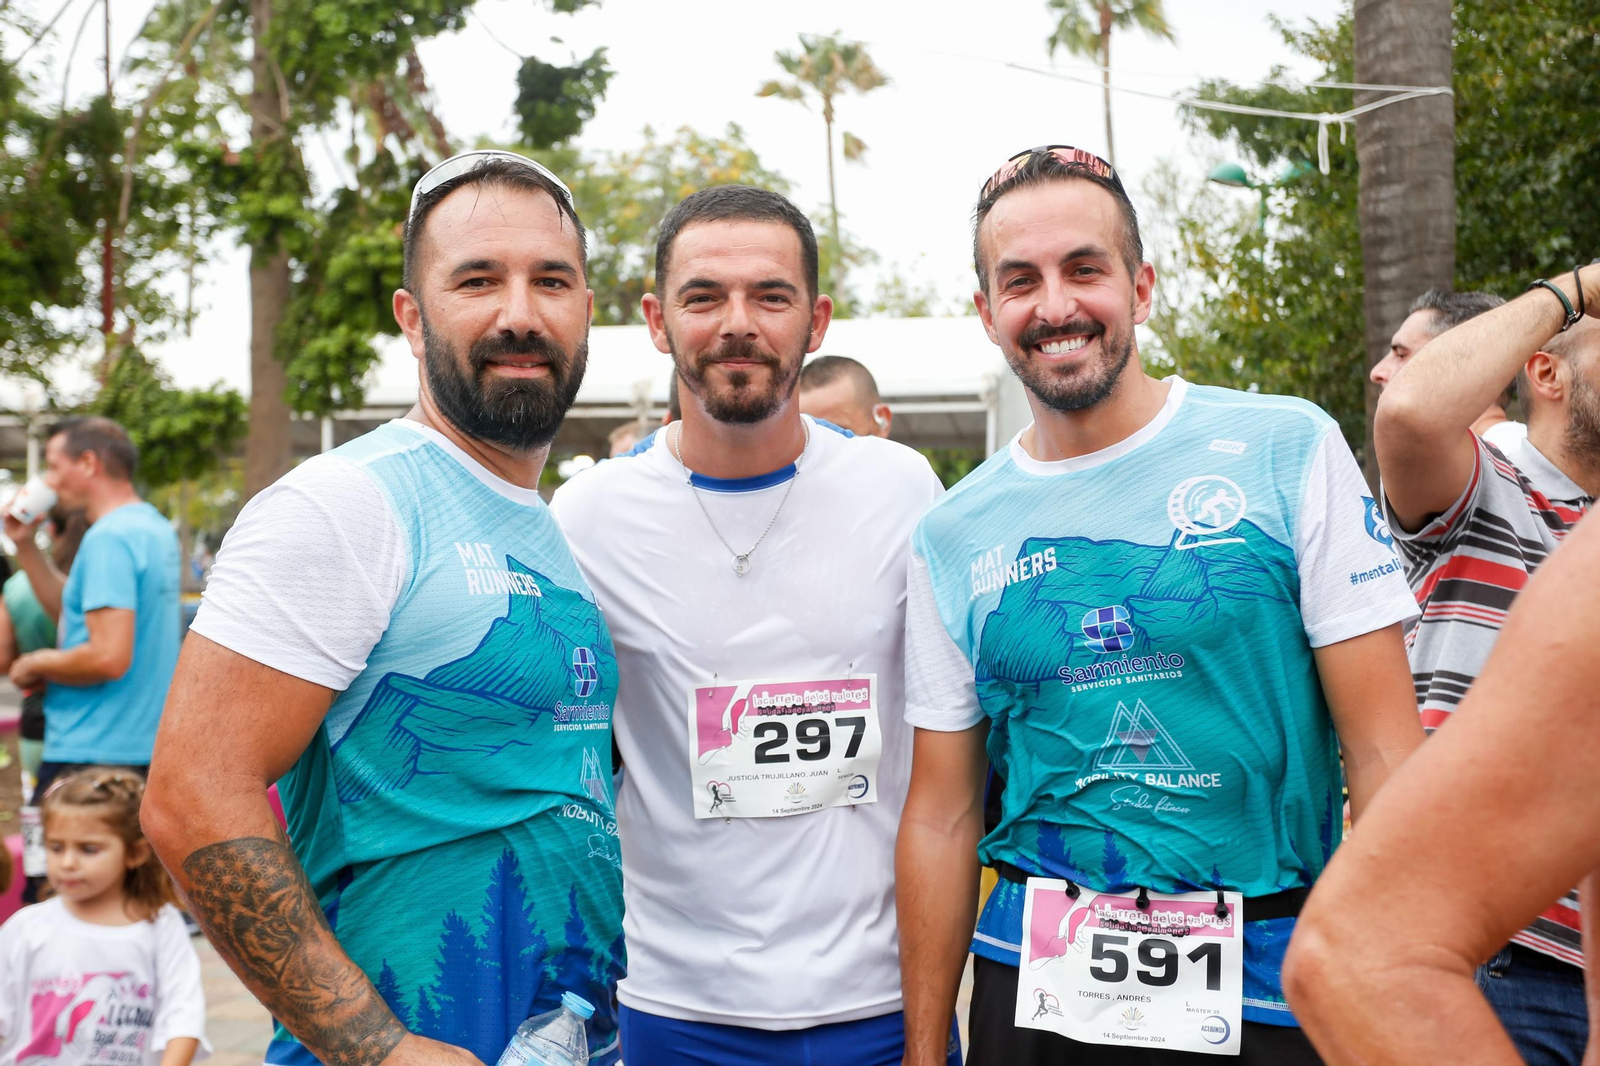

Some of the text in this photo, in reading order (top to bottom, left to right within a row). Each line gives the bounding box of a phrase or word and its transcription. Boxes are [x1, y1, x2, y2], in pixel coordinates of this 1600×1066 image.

[454, 541, 498, 568] MAT
[970, 544, 1005, 582] MAT
[465, 569, 543, 597] RUNNERS
[970, 547, 1057, 600] RUNNERS
[1058, 651, 1185, 685] Sarmiento
[1071, 670, 1183, 693] SERVICIOS SANITARIOS
[553, 700, 610, 722] Sarmiento
[553, 722, 608, 732] SERVICIOS SANITARIOS
[753, 716, 867, 764] 297
[762, 771, 809, 780] TRUJILLANO,
[1145, 772, 1222, 788] BALANCE
[780, 806, 811, 814] Septiembre
[1089, 933, 1222, 991] 591
[1077, 990, 1111, 1000] TORRES
[1116, 993, 1152, 1003] ANDRÉS
[1186, 1007, 1211, 1015] MASTER
[1111, 1032, 1149, 1042] Septiembre
[1150, 1035, 1166, 1043] 2024
